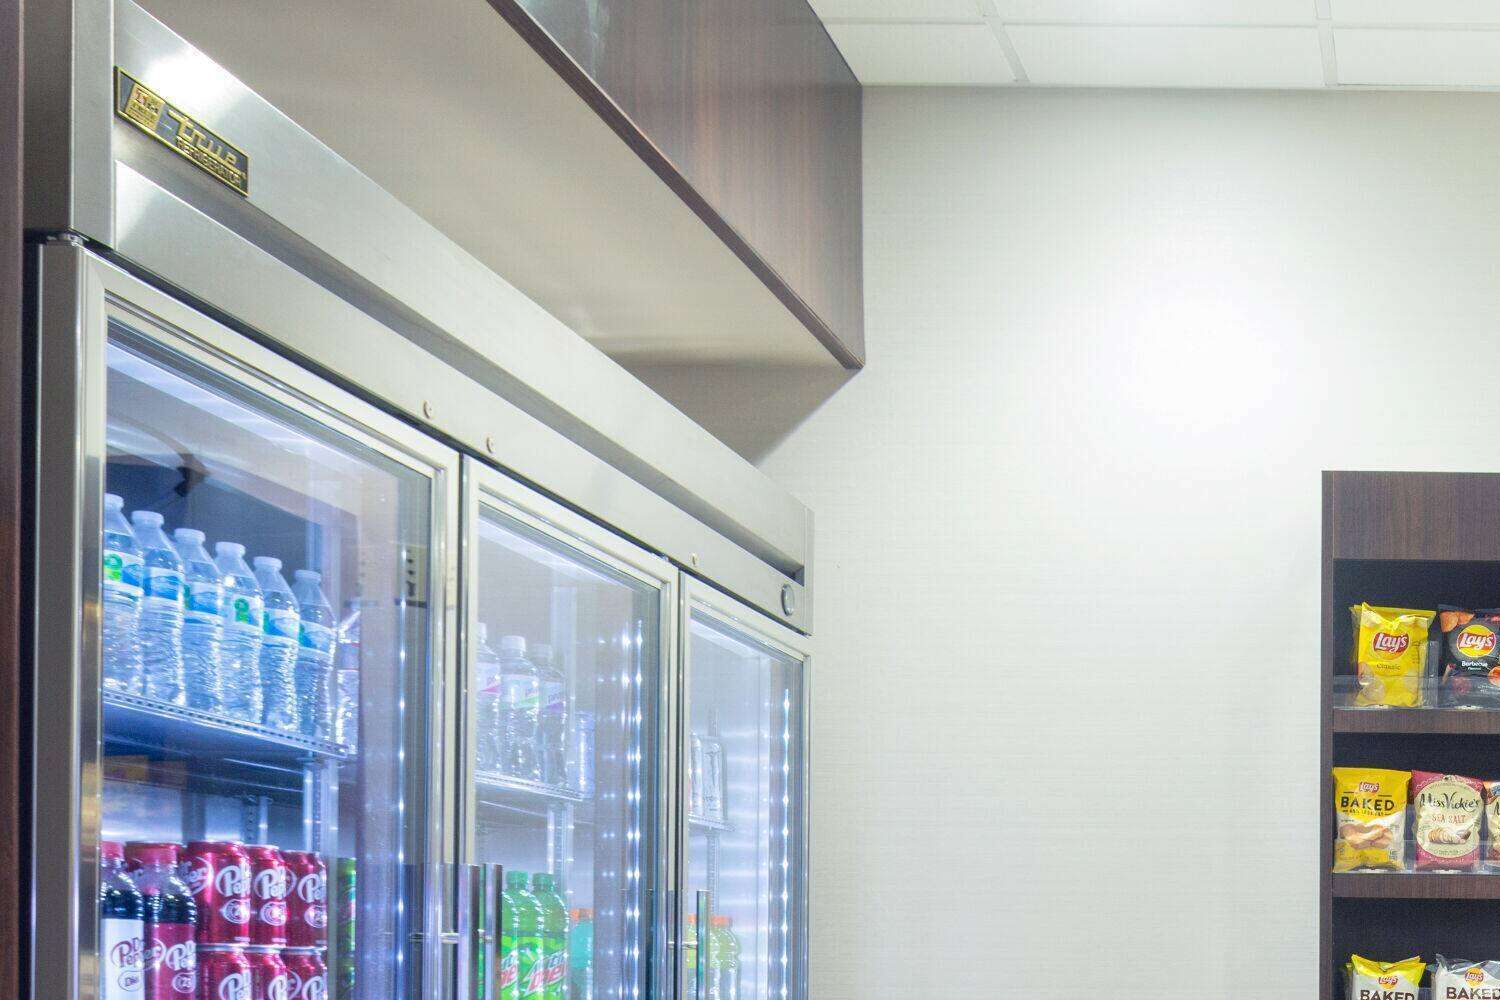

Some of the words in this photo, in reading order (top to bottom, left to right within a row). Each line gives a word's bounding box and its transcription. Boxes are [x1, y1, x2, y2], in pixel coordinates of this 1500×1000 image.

[1375, 632, 1408, 652] Lay's
[1459, 631, 1496, 650] Lay's
[1376, 662, 1401, 671] Classic
[1461, 660, 1488, 668] Barbecue
[1359, 782, 1379, 793] Lay's
[1340, 796, 1395, 811] BAKED
[1378, 975, 1399, 985] Lay's
